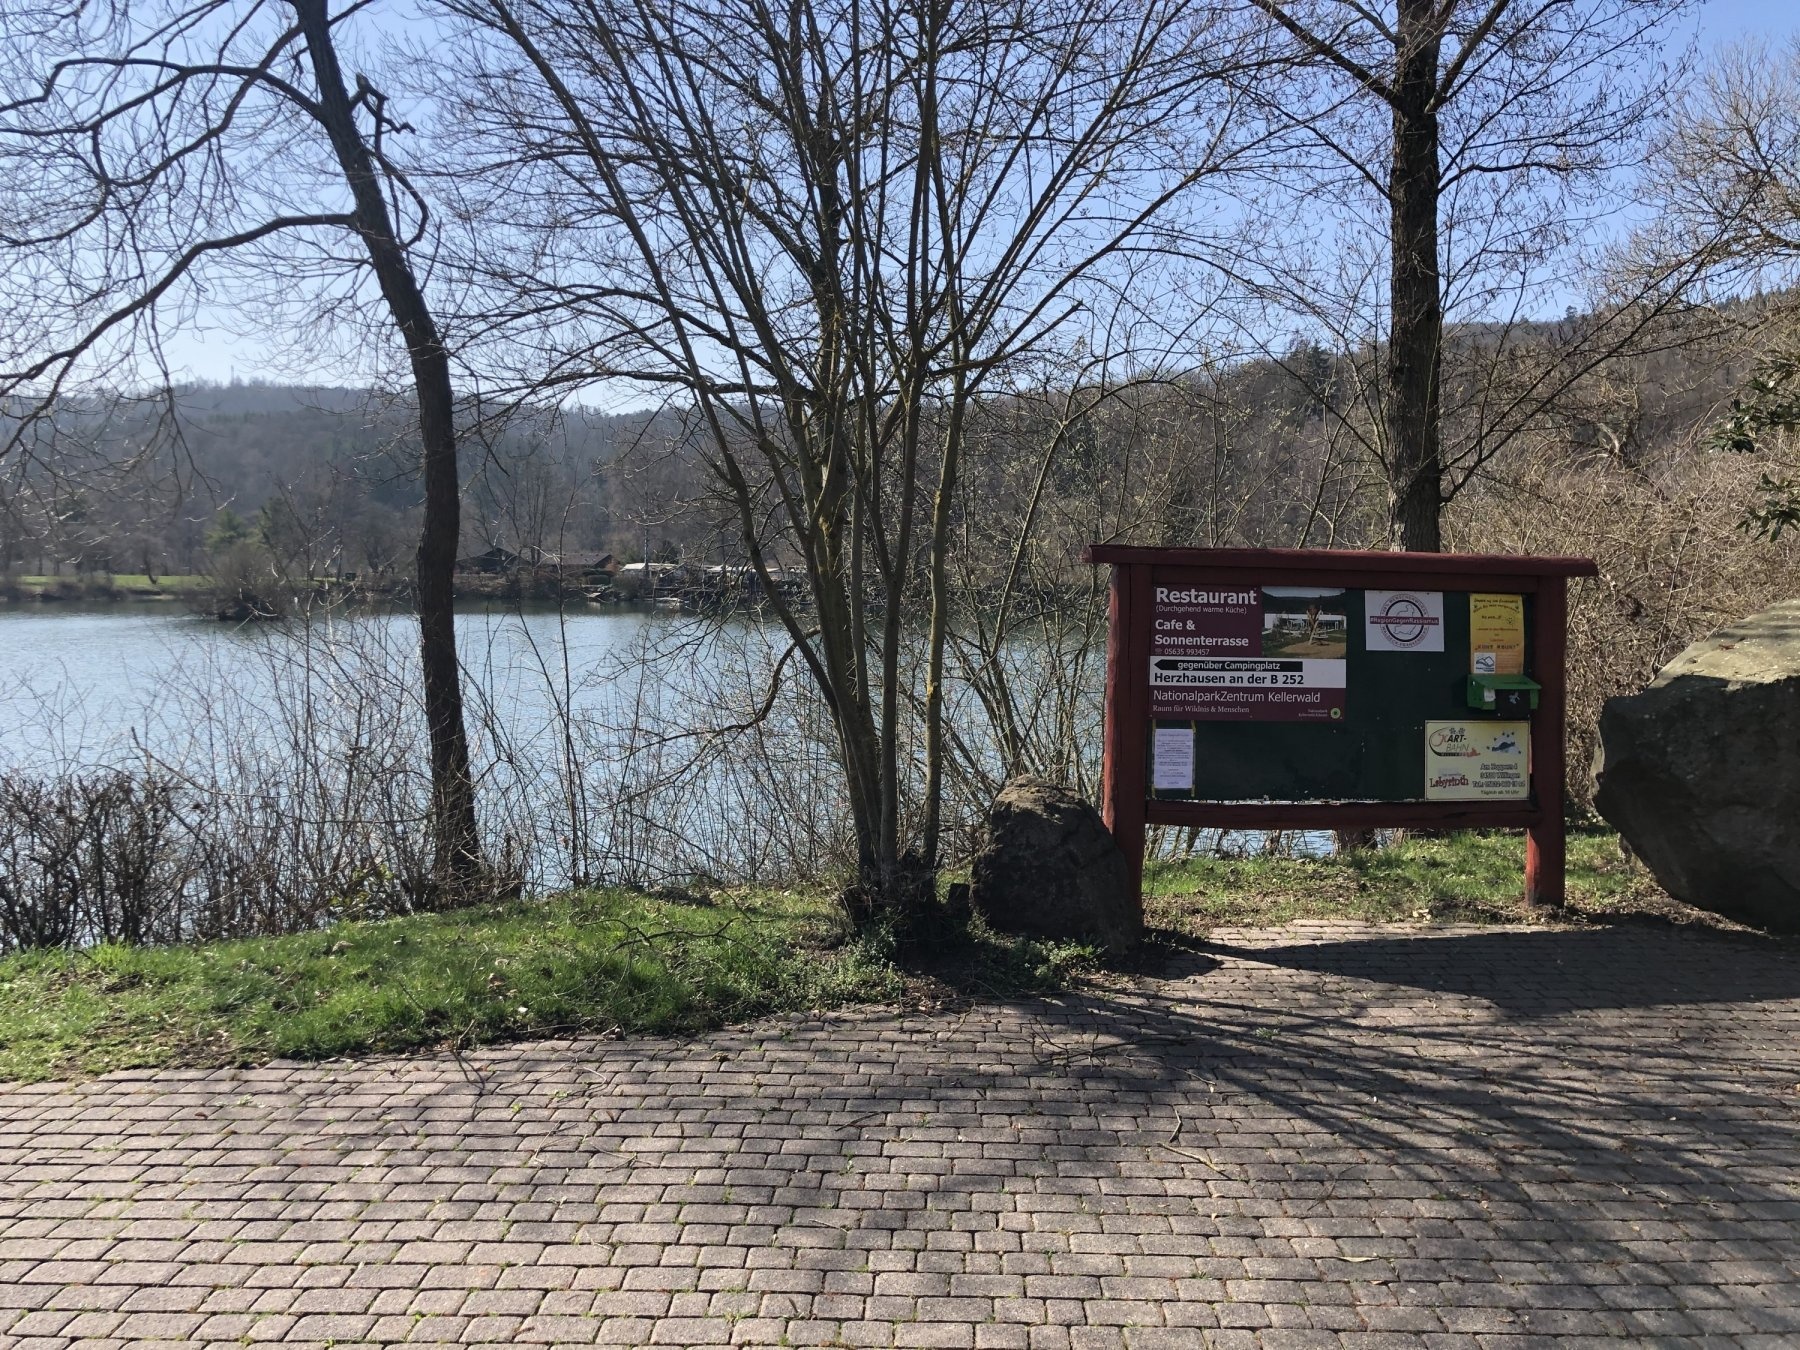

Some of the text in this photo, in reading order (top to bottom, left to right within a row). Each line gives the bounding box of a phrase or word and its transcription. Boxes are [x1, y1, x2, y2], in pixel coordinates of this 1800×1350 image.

[1156, 588, 1257, 605] Restaurant
[1156, 605, 1201, 613] (Durchgehend
[1225, 606, 1247, 614] Küche)
[1155, 619, 1196, 630] Cafe &
[1155, 634, 1249, 646] Sonnenterrasse
[1177, 661, 1281, 672] gegenüber Campingplatz
[1154, 672, 1304, 685] Herzhausen an der B 252
[1153, 690, 1321, 703] NationalparkZentrum Kellerwald
